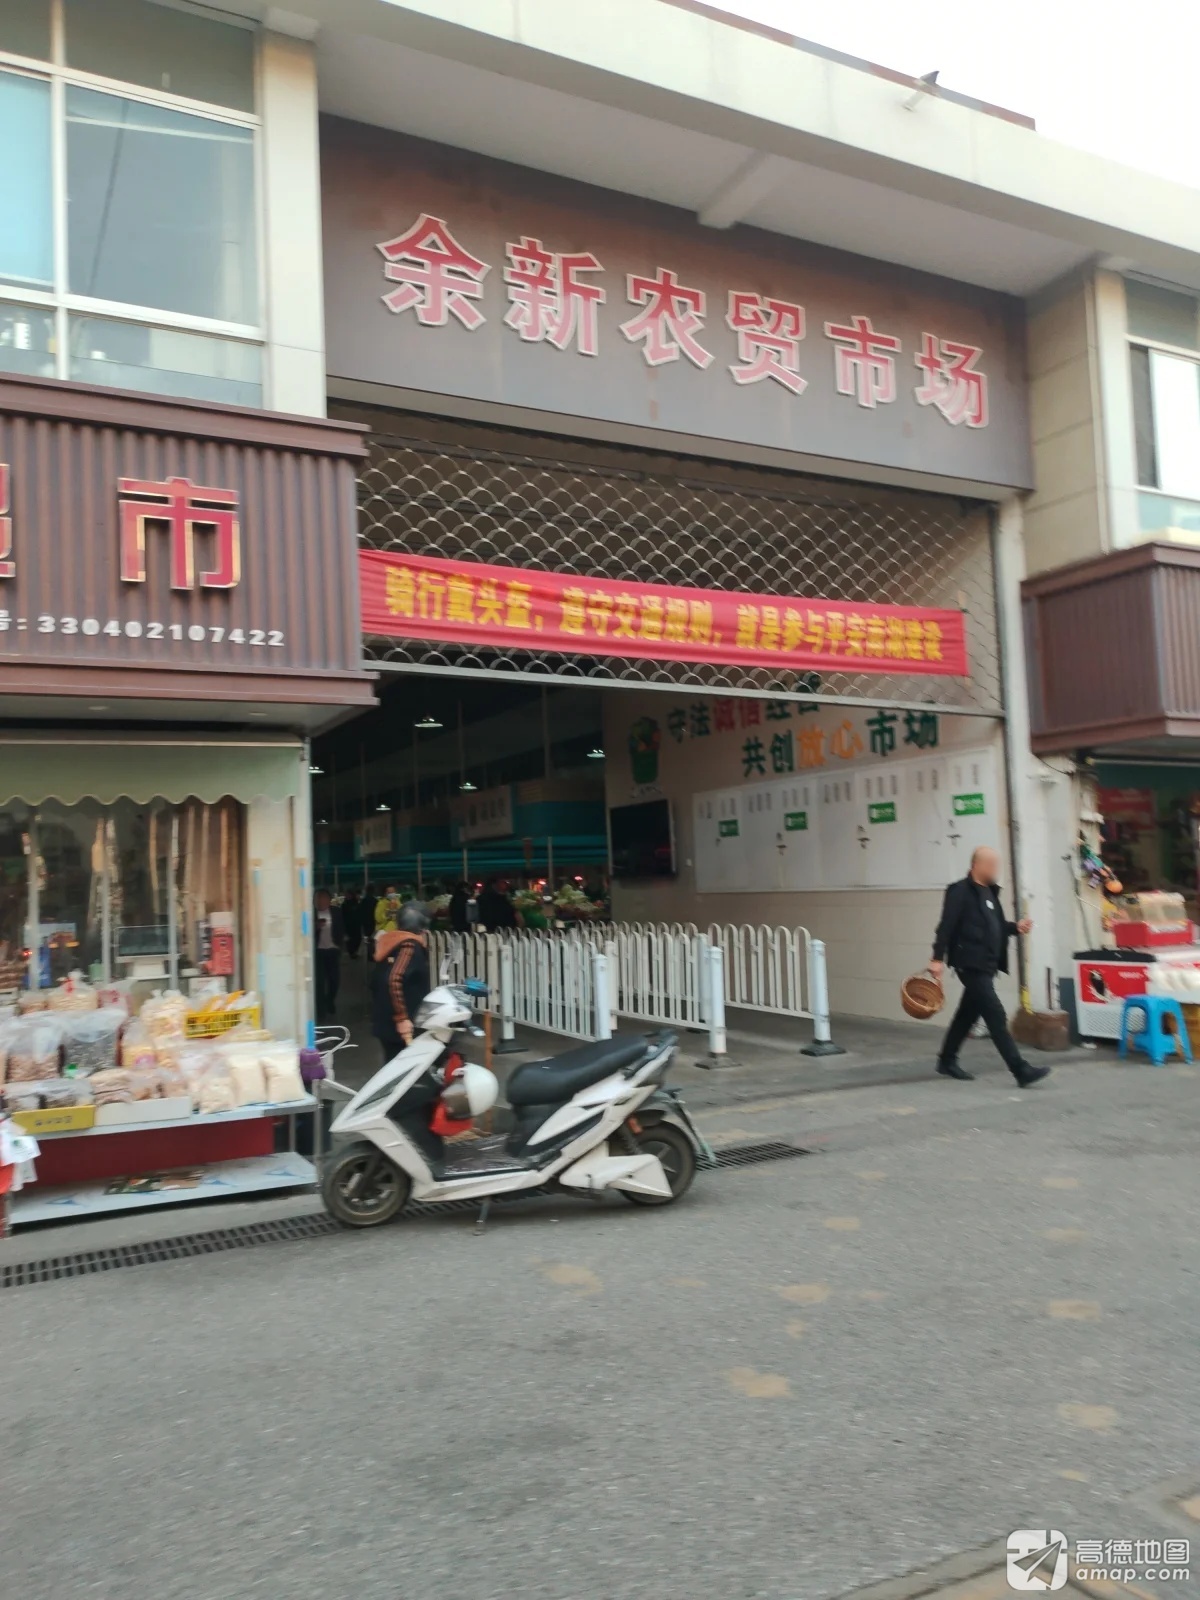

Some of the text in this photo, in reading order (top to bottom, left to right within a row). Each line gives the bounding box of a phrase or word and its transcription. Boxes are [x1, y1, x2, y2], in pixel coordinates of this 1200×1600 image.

[376, 212, 990, 429] 余新农贸市场
[736, 703, 940, 777] 共创放心市场
